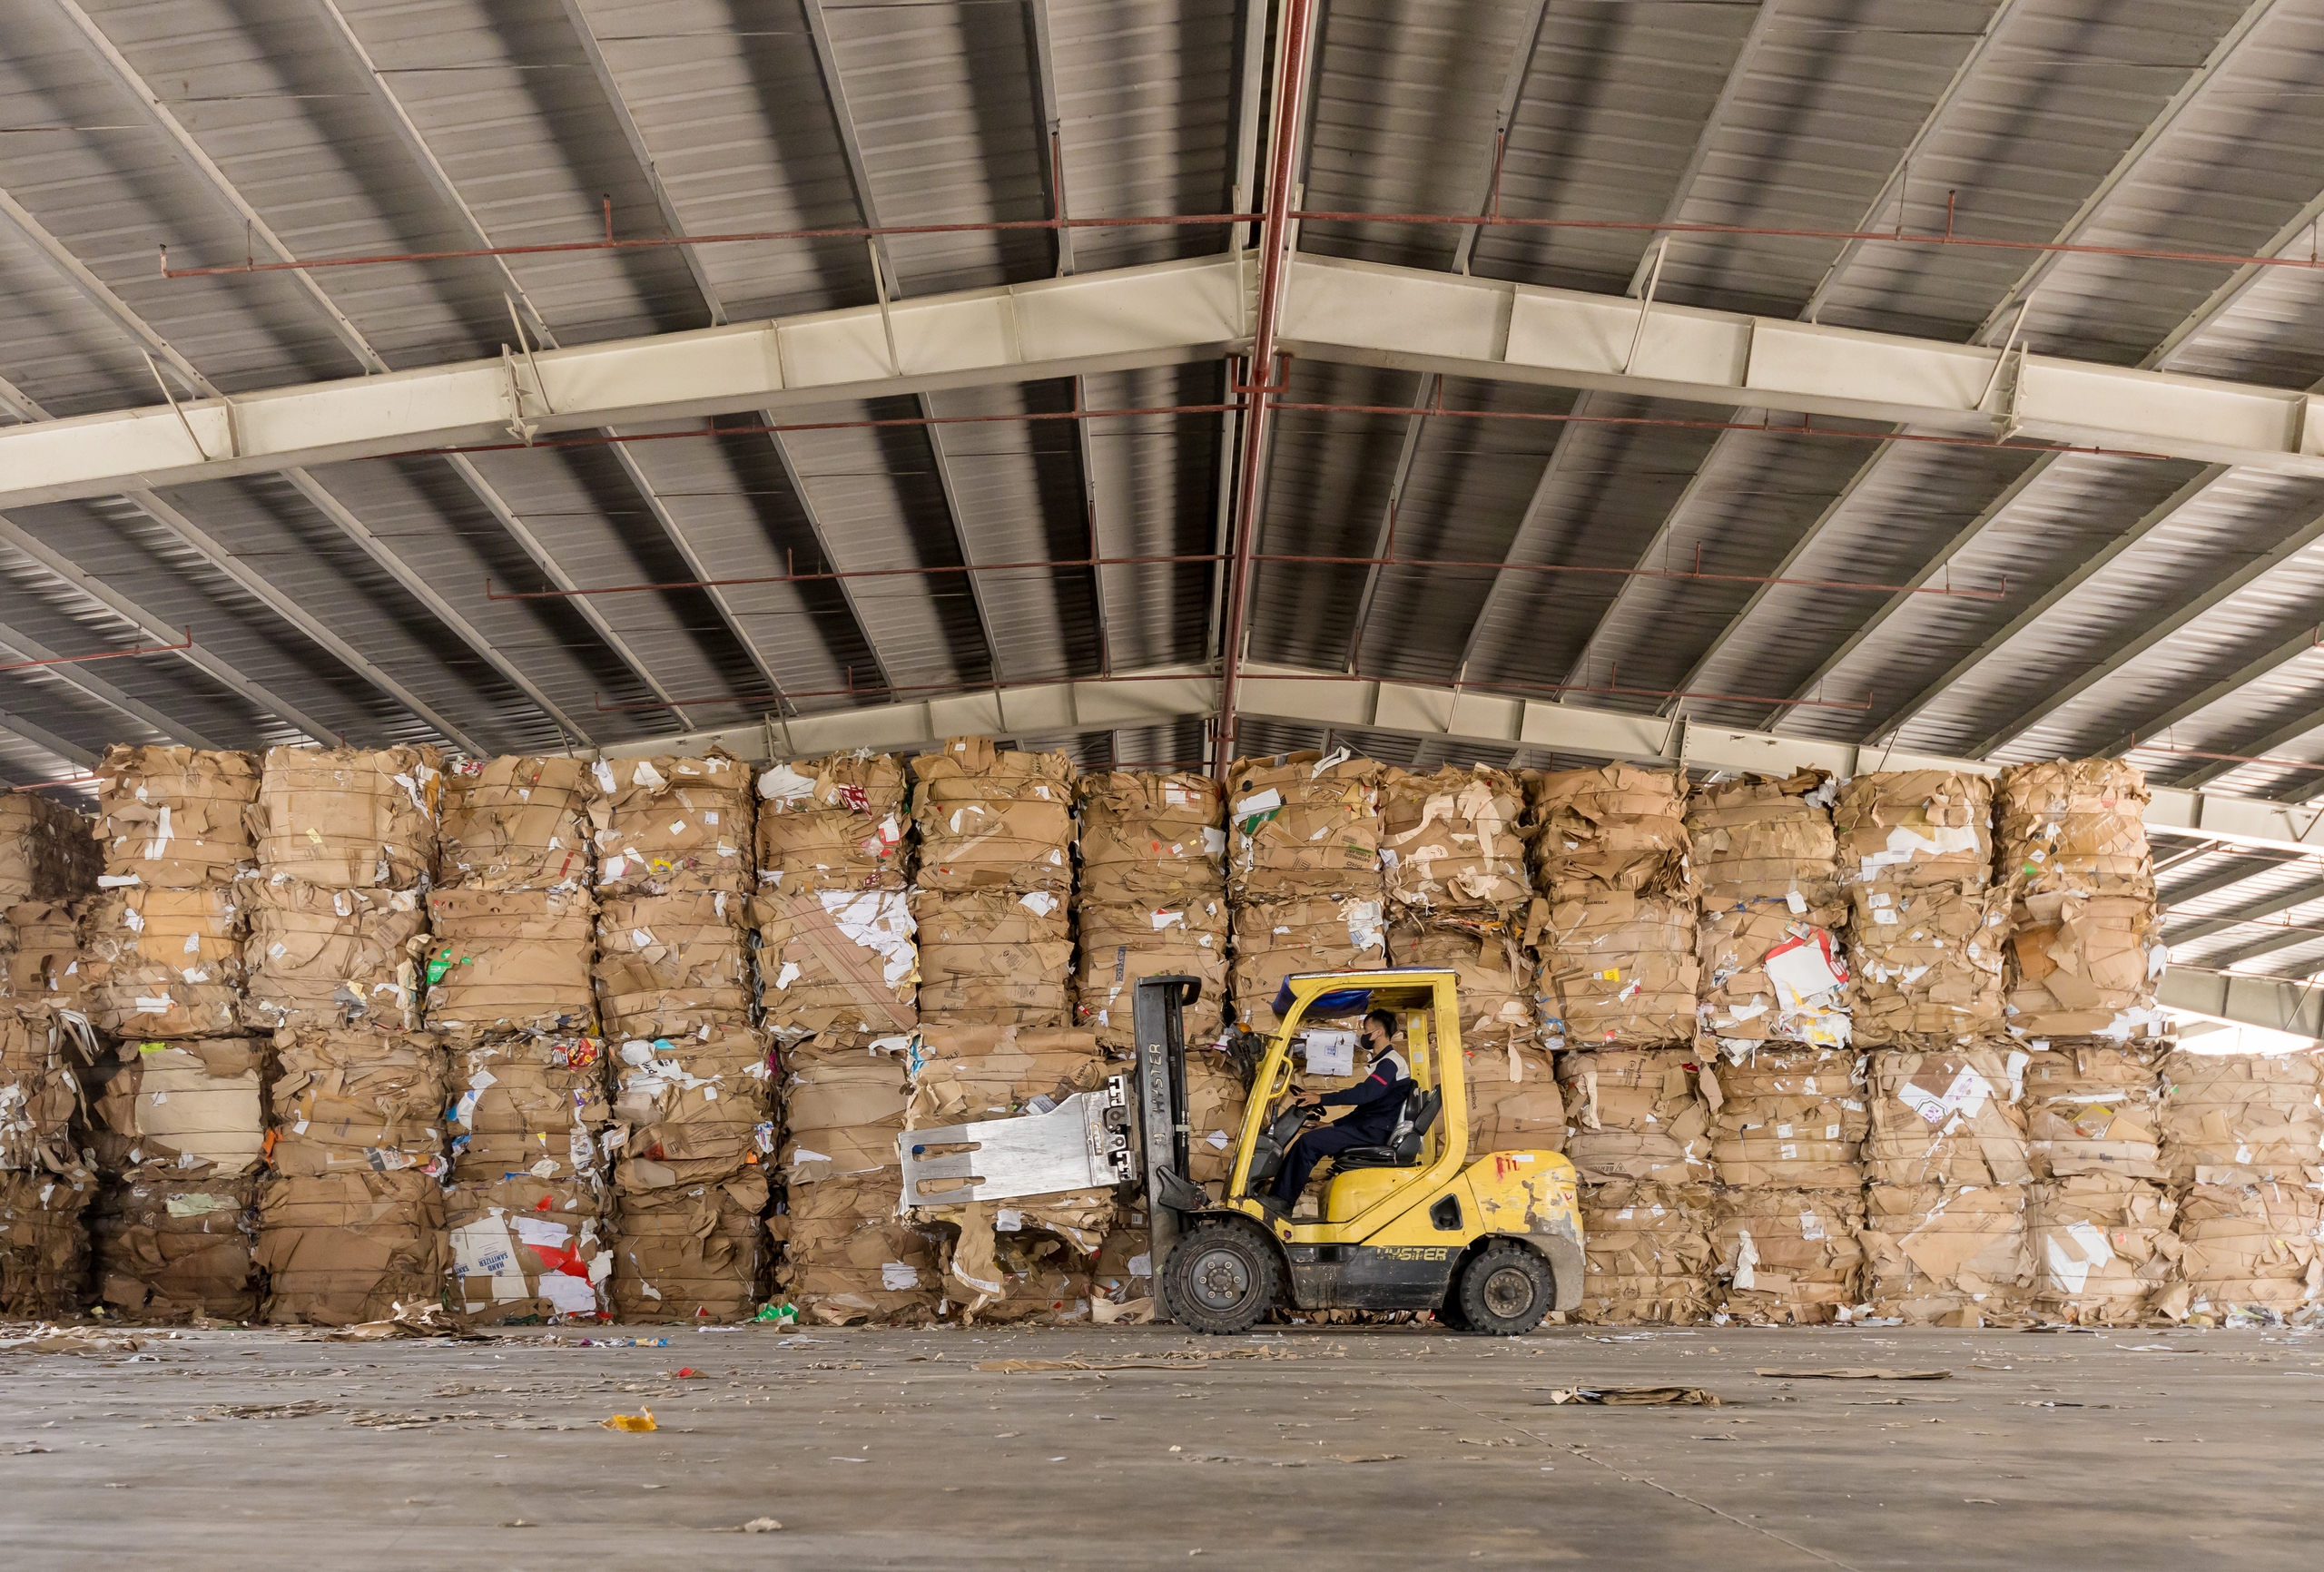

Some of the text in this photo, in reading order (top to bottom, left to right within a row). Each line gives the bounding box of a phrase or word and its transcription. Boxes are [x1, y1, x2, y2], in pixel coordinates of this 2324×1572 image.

[763, 840, 771, 871] PORK
[1344, 851, 1371, 863] ANTIFREEZE
[1345, 849, 1367, 858] COOLANT
[1148, 1043, 1165, 1115] HYSTER
[478, 1252, 508, 1267] SANITIZER
[1377, 1246, 1448, 1262] HYSTER
[487, 1260, 505, 1272] HAND
